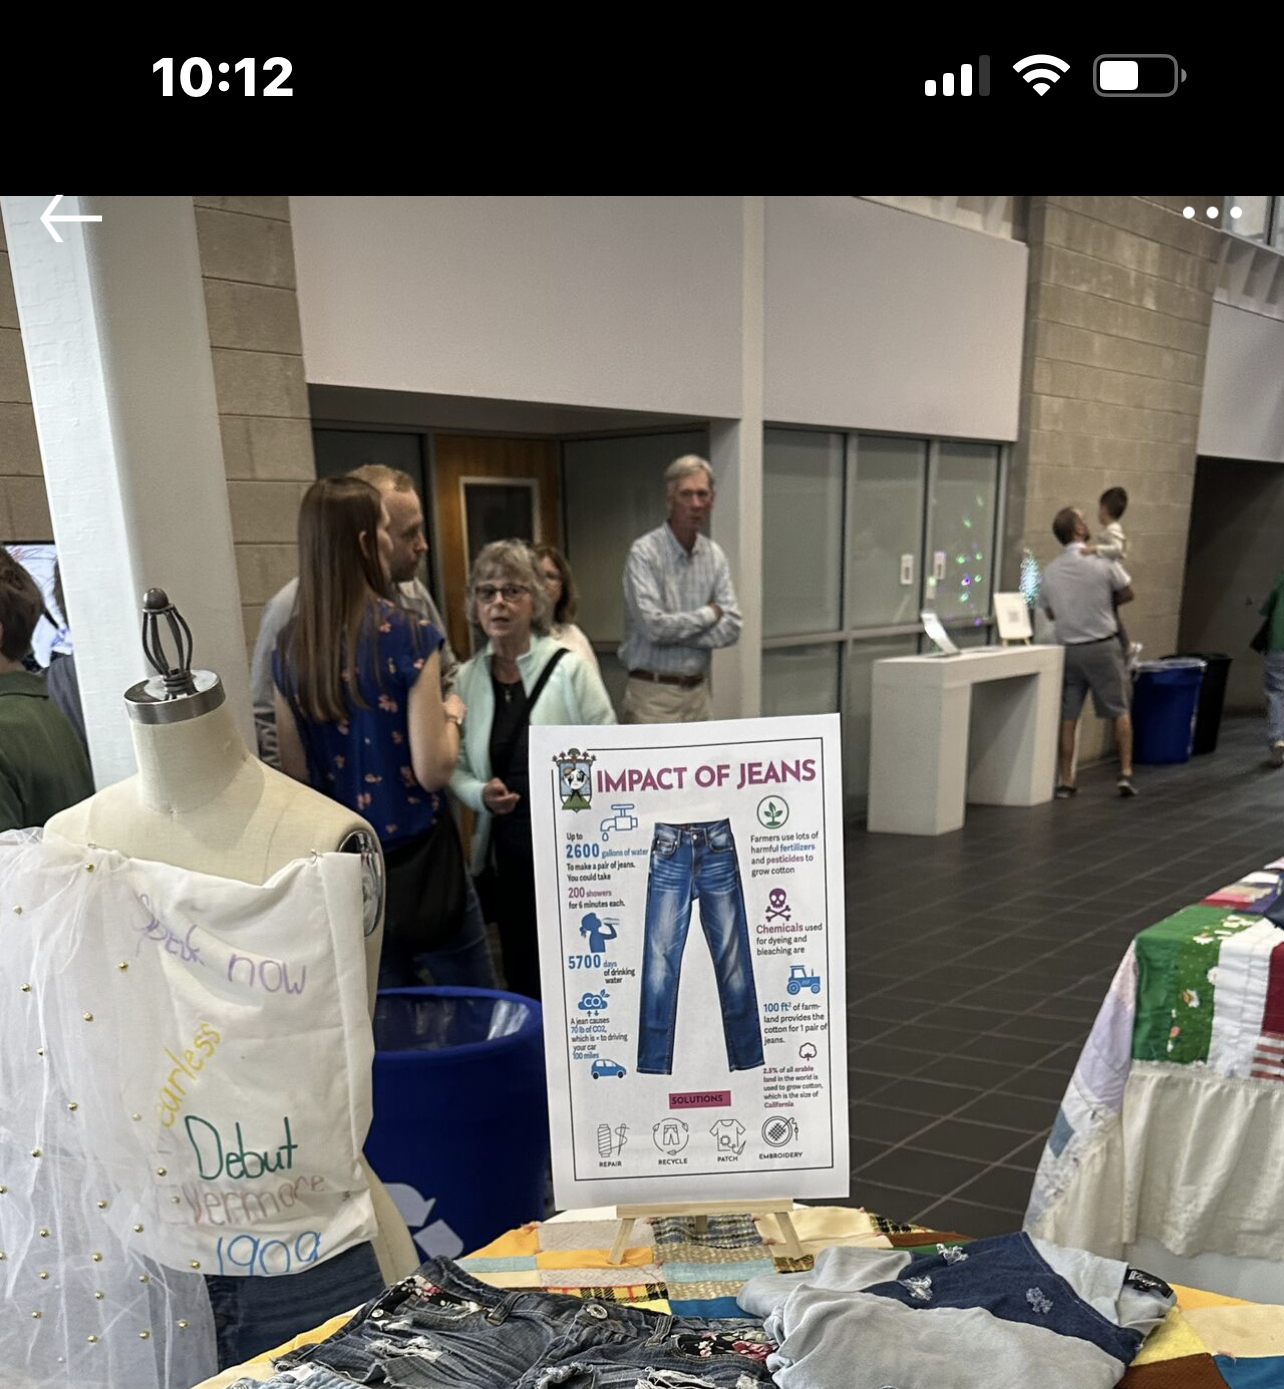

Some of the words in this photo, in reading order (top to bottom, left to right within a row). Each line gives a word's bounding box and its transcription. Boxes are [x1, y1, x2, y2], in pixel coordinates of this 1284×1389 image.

[597, 767, 687, 793] IMPACT
[695, 764, 730, 788] OF
[737, 759, 816, 789] JEANS
[566, 832, 575, 842] Up
[751, 835, 780, 843] Farmers
[796, 832, 810, 840] lots
[811, 831, 819, 839] of
[566, 843, 600, 859] 2600
[602, 849, 623, 859] gallons
[751, 845, 779, 854] harmful
[780, 843, 815, 852] fertilizers
[751, 856, 765, 865] and
[766, 855, 804, 865] pesticides
[806, 854, 814, 862] to
[566, 863, 574, 871] To
[575, 862, 591, 870] make
[598, 861, 609, 871] pair
[610, 861, 617, 869] of
[617, 861, 635, 871] jeans.
[567, 874, 578, 882] You
[579, 873, 596, 881] could
[752, 869, 770, 878] grow
[771, 867, 795, 875] cotton
[568, 887, 585, 898] 200
[586, 889, 612, 898] showers
[569, 901, 577, 909] for
[579, 901, 583, 909] 6
[584, 900, 608, 908] minutes
[609, 899, 625, 907] each.
[756, 923, 804, 934] Chemicals
[805, 923, 823, 931] used
[756, 937, 767, 945] for
[768, 936, 792, 946] dyeing
[793, 935, 808, 943] and
[757, 947, 792, 956] bleaching
[568, 955, 601, 969] 5700
[603, 960, 617, 969] days
[228, 954, 306, 995] now
[611, 967, 636, 977] drinking
[763, 1003, 779, 1012] 100
[793, 1003, 801, 1011] of
[802, 1002, 821, 1010] farm-
[576, 1017, 589, 1026] jean
[763, 1015, 779, 1023] land
[780, 1014, 811, 1024] provides
[812, 1013, 824, 1021] the
[764, 1026, 787, 1034] cotton
[805, 1023, 819, 1033] pair
[572, 1034, 589, 1042] which
[608, 1033, 628, 1042] driving
[764, 1037, 786, 1046] jeans.
[573, 1045, 586, 1053] your
[671, 1094, 723, 1105] SOLUTIONS
[184, 1115, 298, 1180] Debut
[759, 1152, 803, 1160] EMBROIDERY
[658, 1158, 688, 1166] RECYCLE
